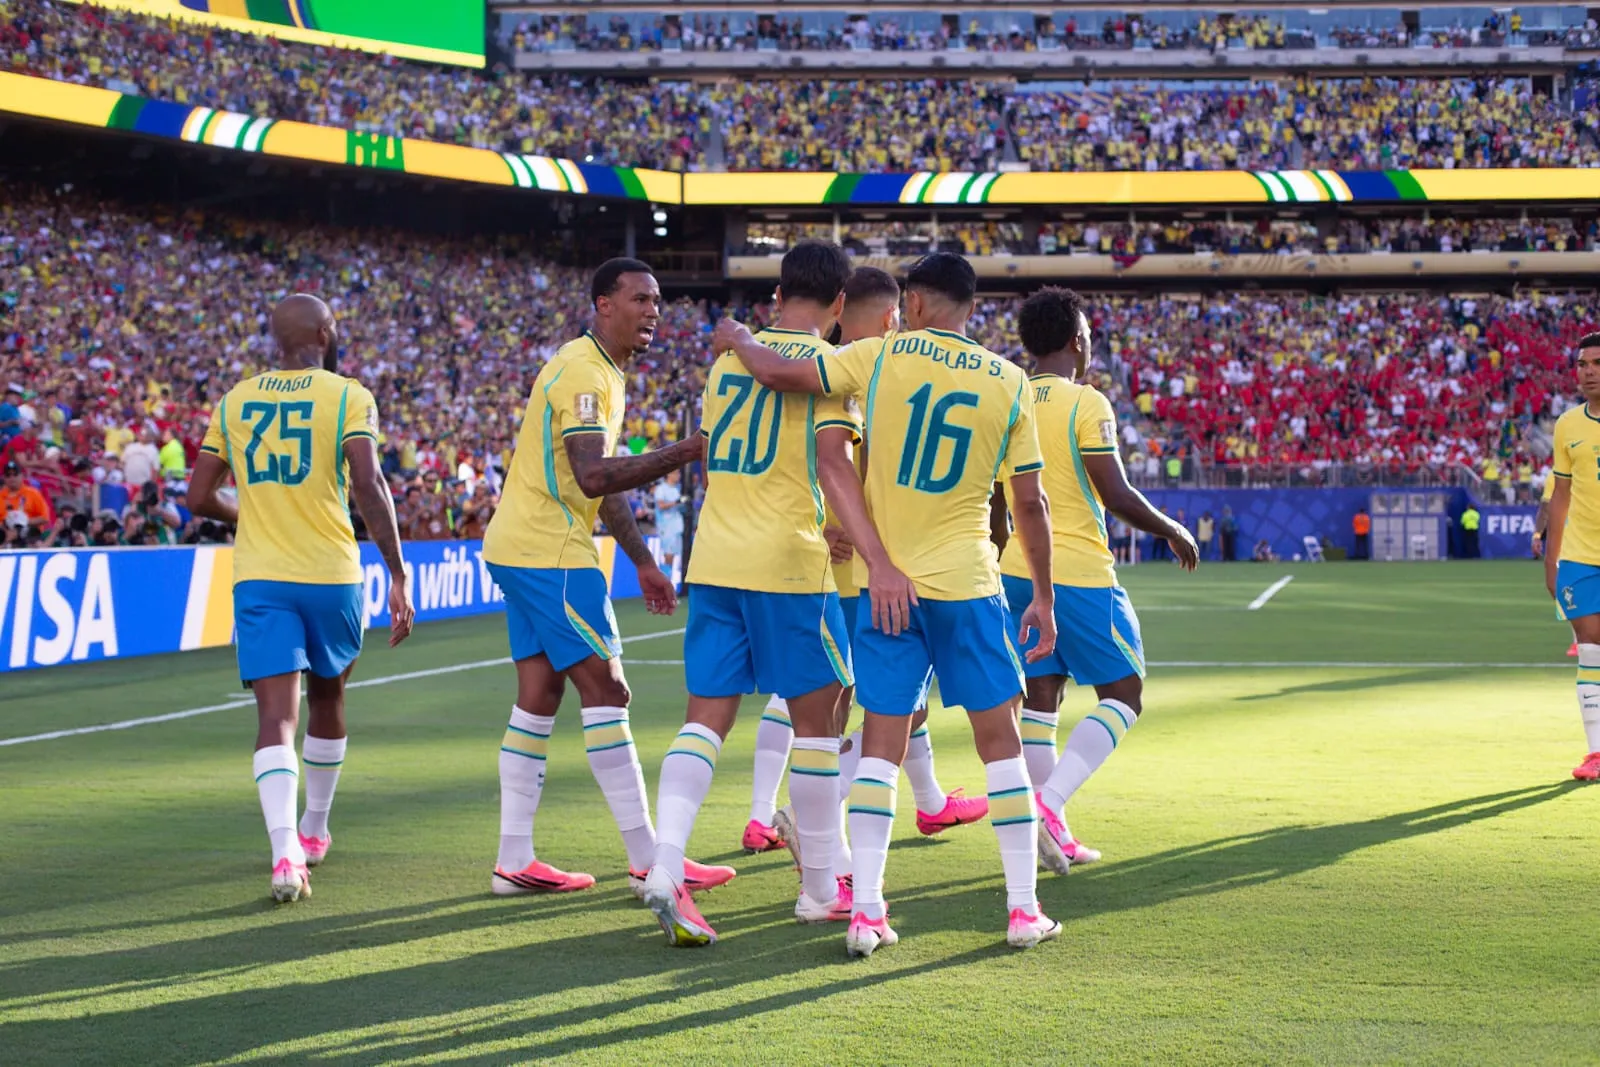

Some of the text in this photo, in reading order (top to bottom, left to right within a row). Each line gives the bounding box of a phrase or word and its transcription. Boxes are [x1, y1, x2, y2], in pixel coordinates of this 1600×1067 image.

[258, 376, 313, 392] THIAGO
[892, 338, 1005, 379] DOUGLAS S.
[1033, 386, 1051, 404] JR.
[241, 400, 314, 485] 25
[708, 374, 784, 475] 20
[896, 382, 980, 494] 16
[1487, 515, 1535, 534] FIFA
[419, 545, 474, 610] with
